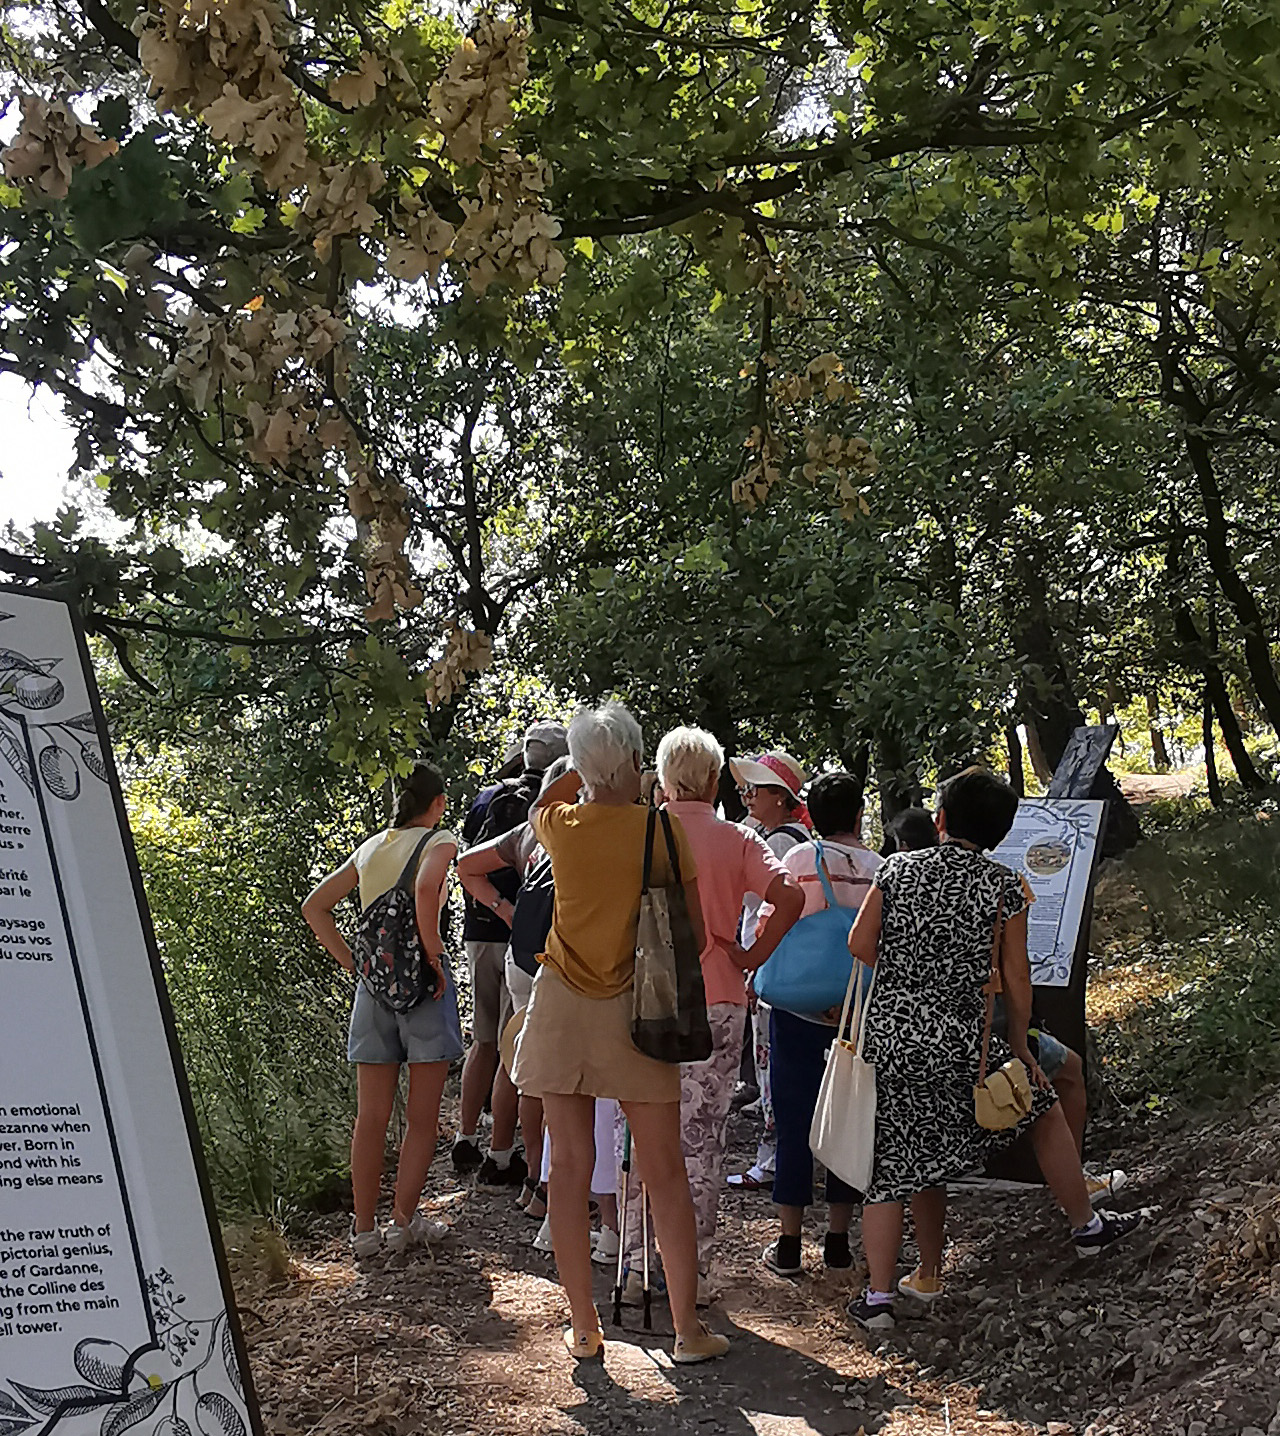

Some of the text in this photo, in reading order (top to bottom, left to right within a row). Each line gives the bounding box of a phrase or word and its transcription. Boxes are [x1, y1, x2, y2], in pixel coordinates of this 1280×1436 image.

[15, 951, 54, 962] cours
[10, 1103, 81, 1117] emotional
[50, 1120, 91, 1134] when
[24, 1154, 58, 1170] with
[59, 1154, 82, 1169] his
[0, 1244, 60, 1264] pictorial
[61, 1241, 113, 1260] genius,
[11, 1264, 27, 1279] of
[29, 1262, 103, 1277] Gardanne,
[27, 1280, 77, 1296] Colline
[79, 1278, 106, 1293] des
[15, 1302, 55, 1316] from
[55, 1298, 81, 1313] the
[83, 1294, 120, 1311] main
[15, 1321, 63, 1335] tower.
